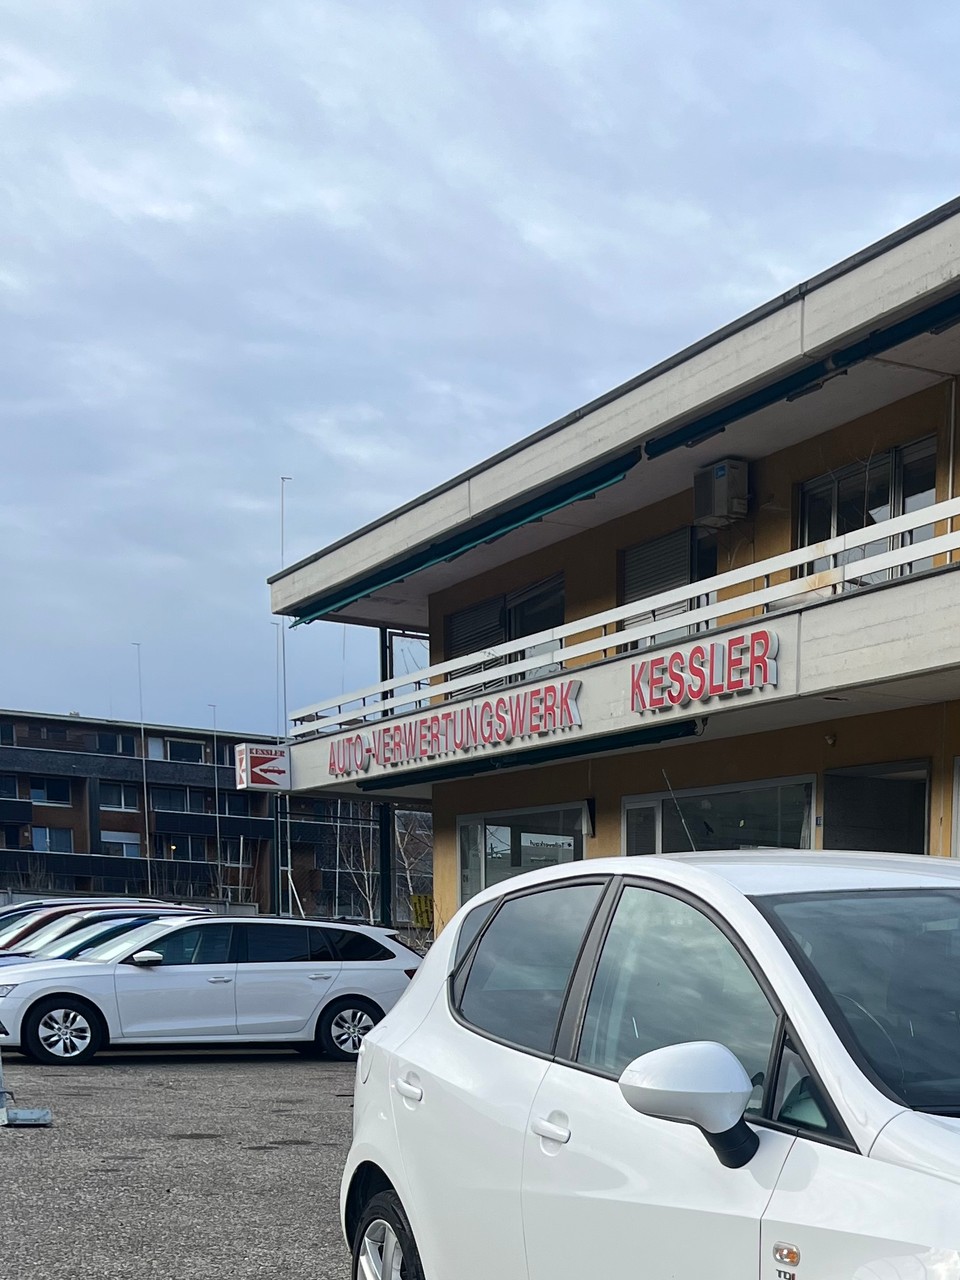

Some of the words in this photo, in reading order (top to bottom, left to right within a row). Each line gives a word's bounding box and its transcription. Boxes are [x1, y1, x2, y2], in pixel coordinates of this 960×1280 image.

[328, 680, 582, 776] AUTO-VERWERTUNGSWERK
[631, 629, 778, 713] KESSLER
[249, 747, 286, 758] KESSLER
